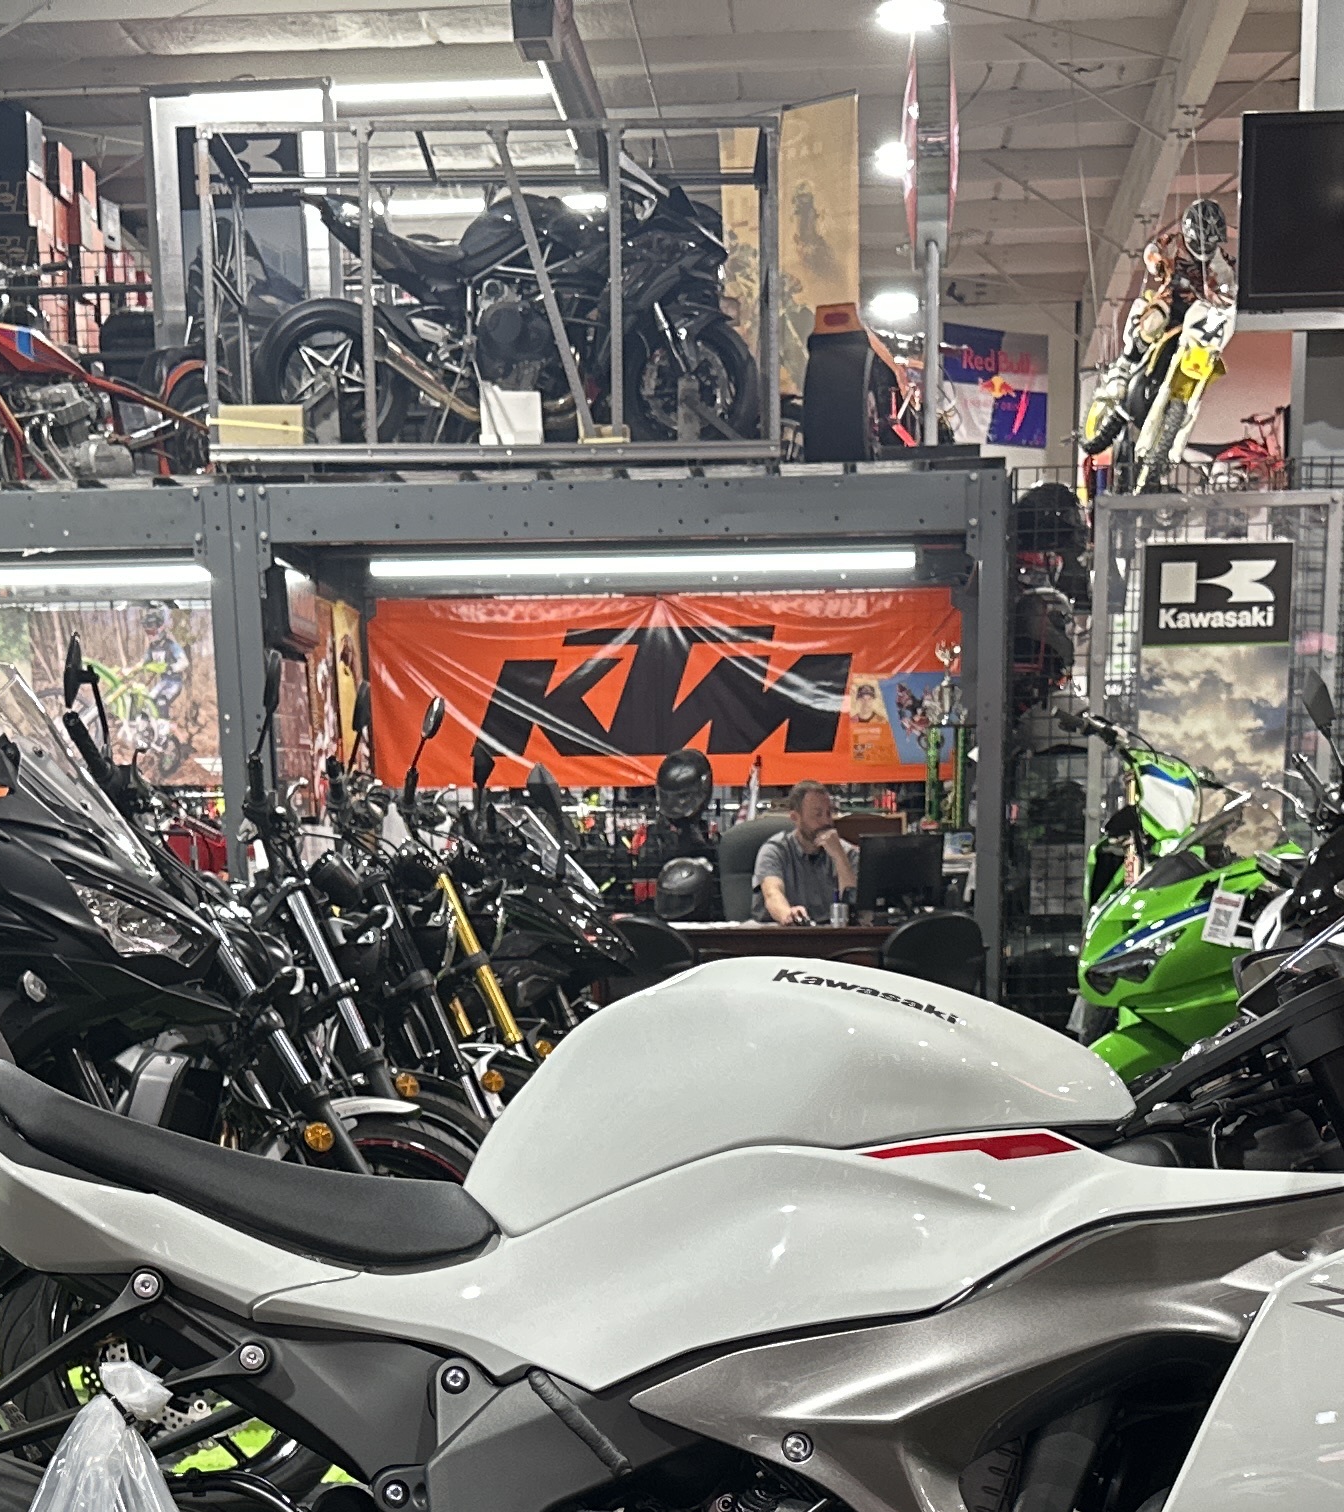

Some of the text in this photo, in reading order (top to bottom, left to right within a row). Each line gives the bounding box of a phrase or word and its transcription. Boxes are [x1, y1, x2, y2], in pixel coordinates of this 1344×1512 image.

[962, 346, 995, 372] Red
[1158, 604, 1275, 630] Kawasaki
[471, 625, 853, 758] KTM
[771, 968, 963, 1026] Kawasaki
